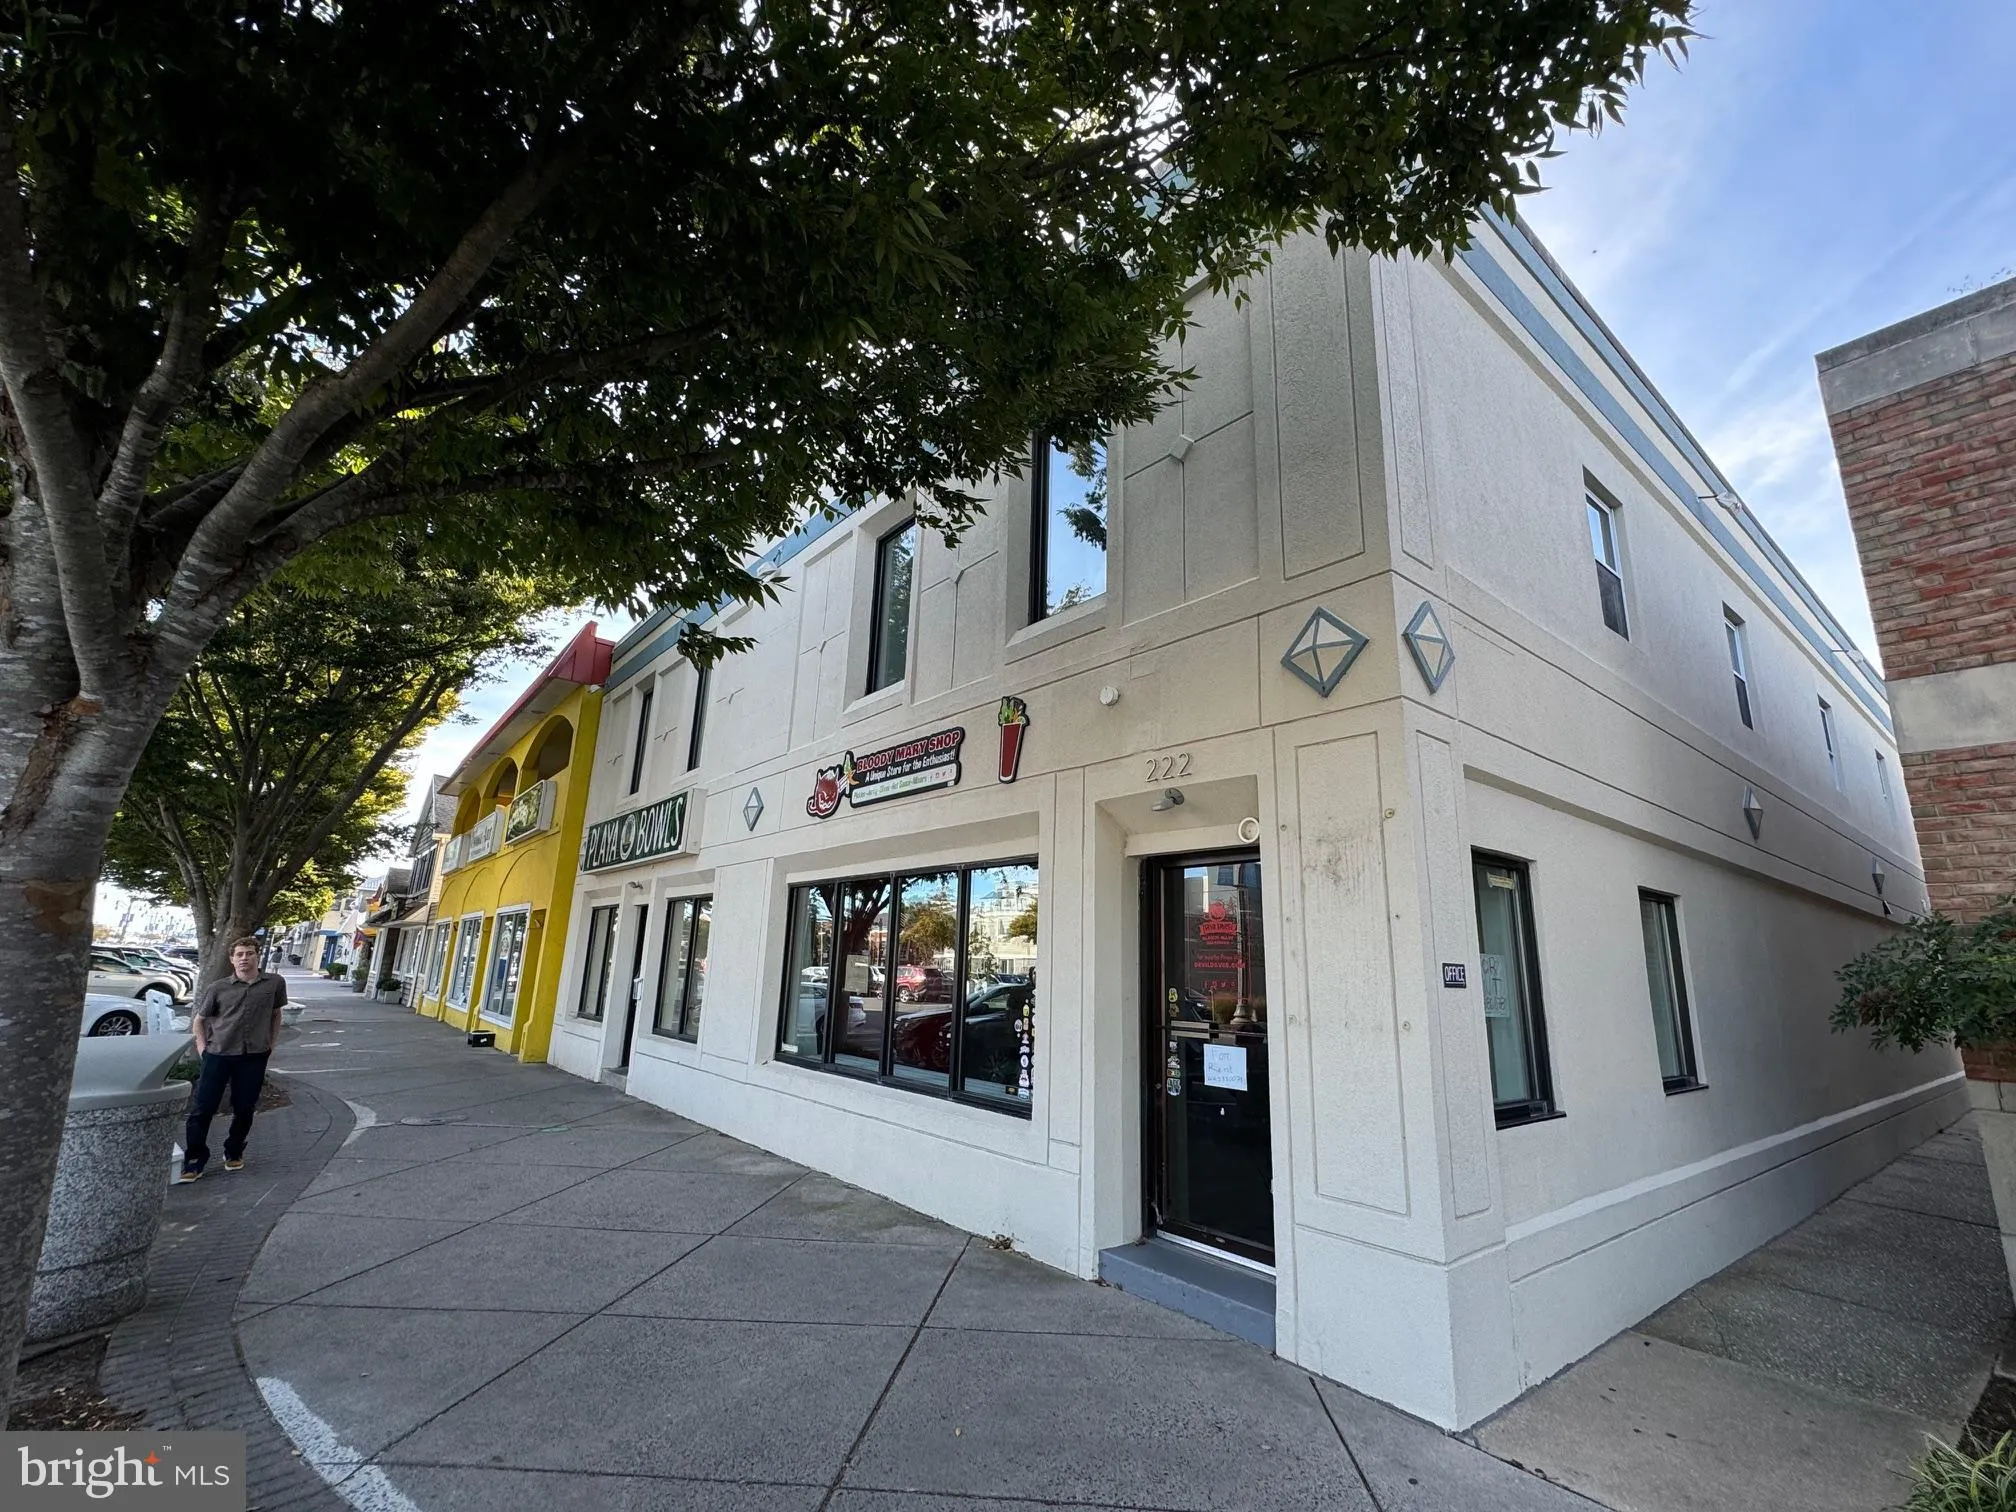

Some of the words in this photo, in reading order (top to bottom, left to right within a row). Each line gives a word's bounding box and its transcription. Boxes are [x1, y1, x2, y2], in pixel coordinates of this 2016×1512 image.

[856, 750, 894, 773] BLOODY
[895, 740, 927, 761] MARY
[928, 730, 960, 752] SHOP
[865, 772, 870, 783] A
[870, 770, 886, 782] Unique
[887, 766, 902, 777] Store
[902, 762, 912, 773] for
[912, 760, 922, 770] the
[1145, 752, 1192, 782] 222
[586, 820, 620, 868] PLAYA
[636, 797, 684, 856] BOWLS
[1444, 966, 1464, 981] OFFICE
